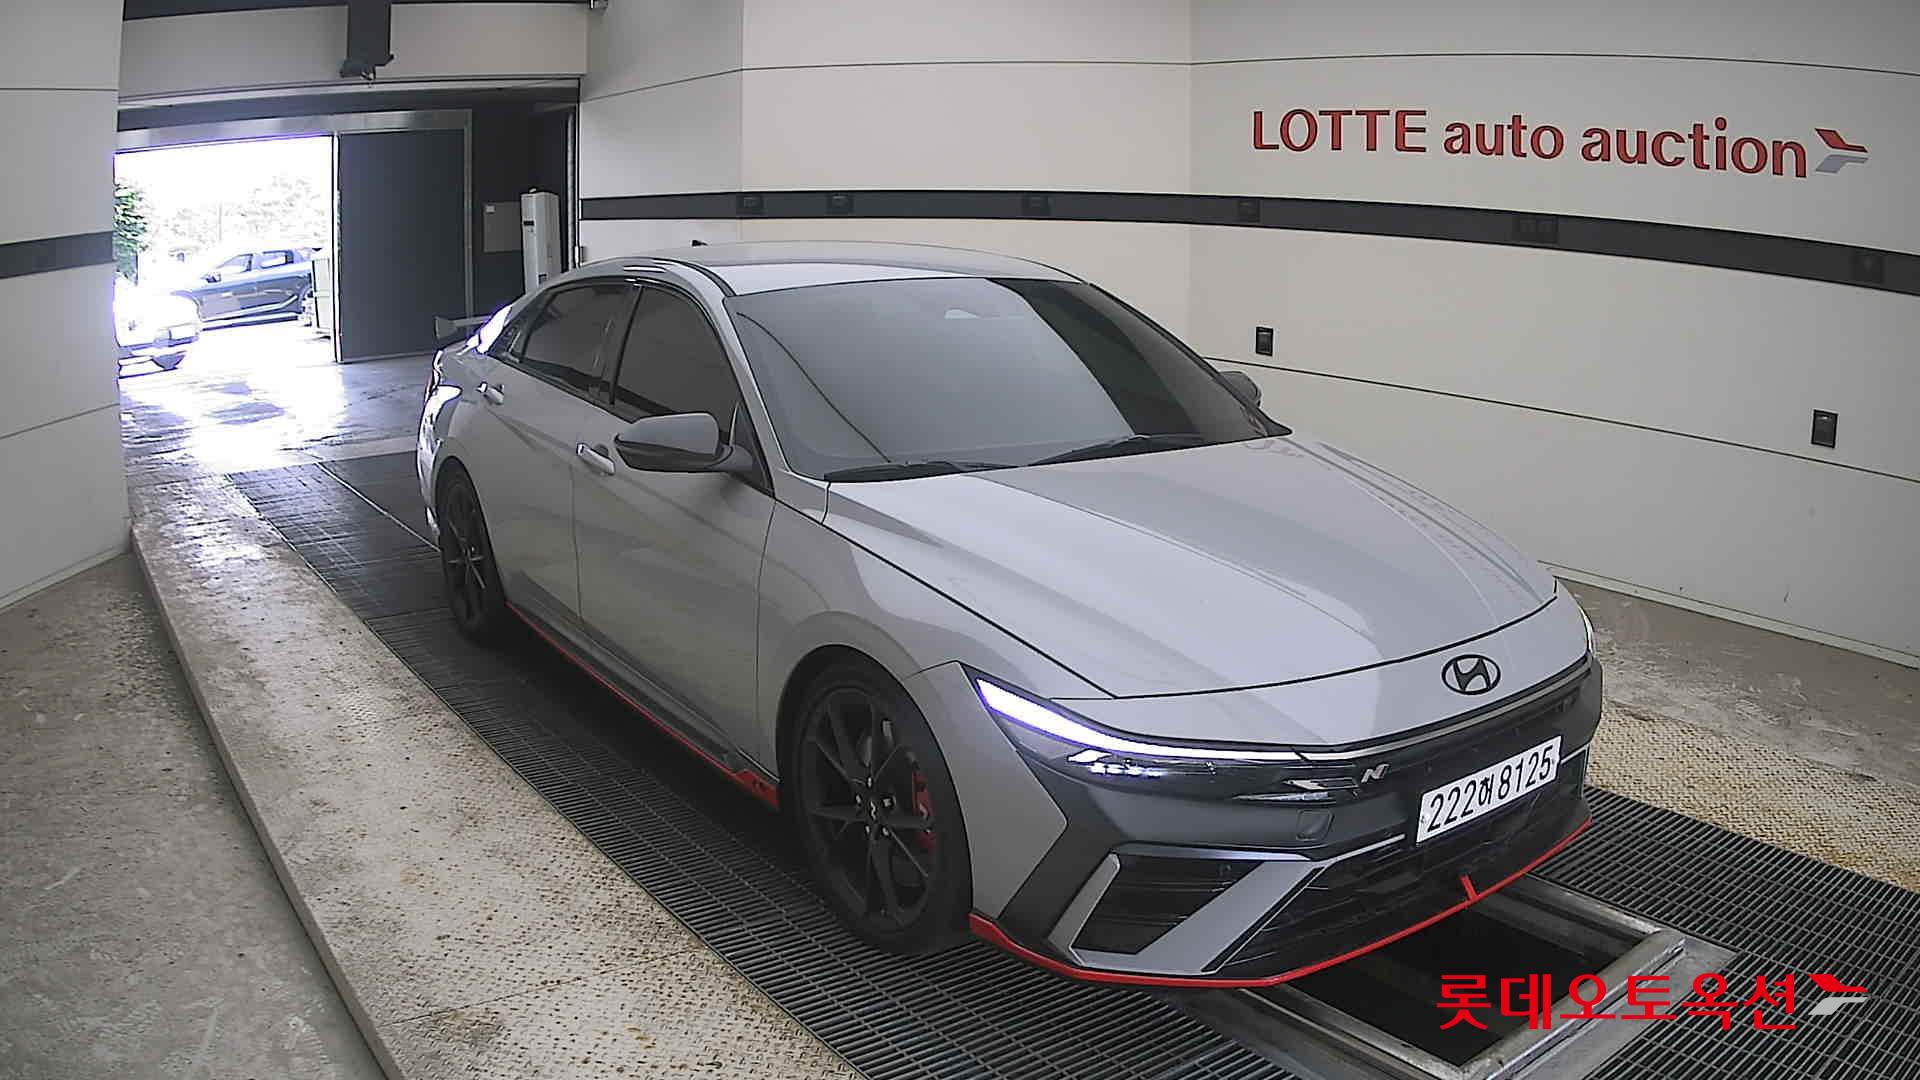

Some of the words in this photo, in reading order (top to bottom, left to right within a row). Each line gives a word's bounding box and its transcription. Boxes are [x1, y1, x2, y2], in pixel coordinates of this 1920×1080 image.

[1253, 109, 1427, 152] LOTTE
[1443, 114, 1566, 159] auto
[1582, 117, 1808, 178] auction
